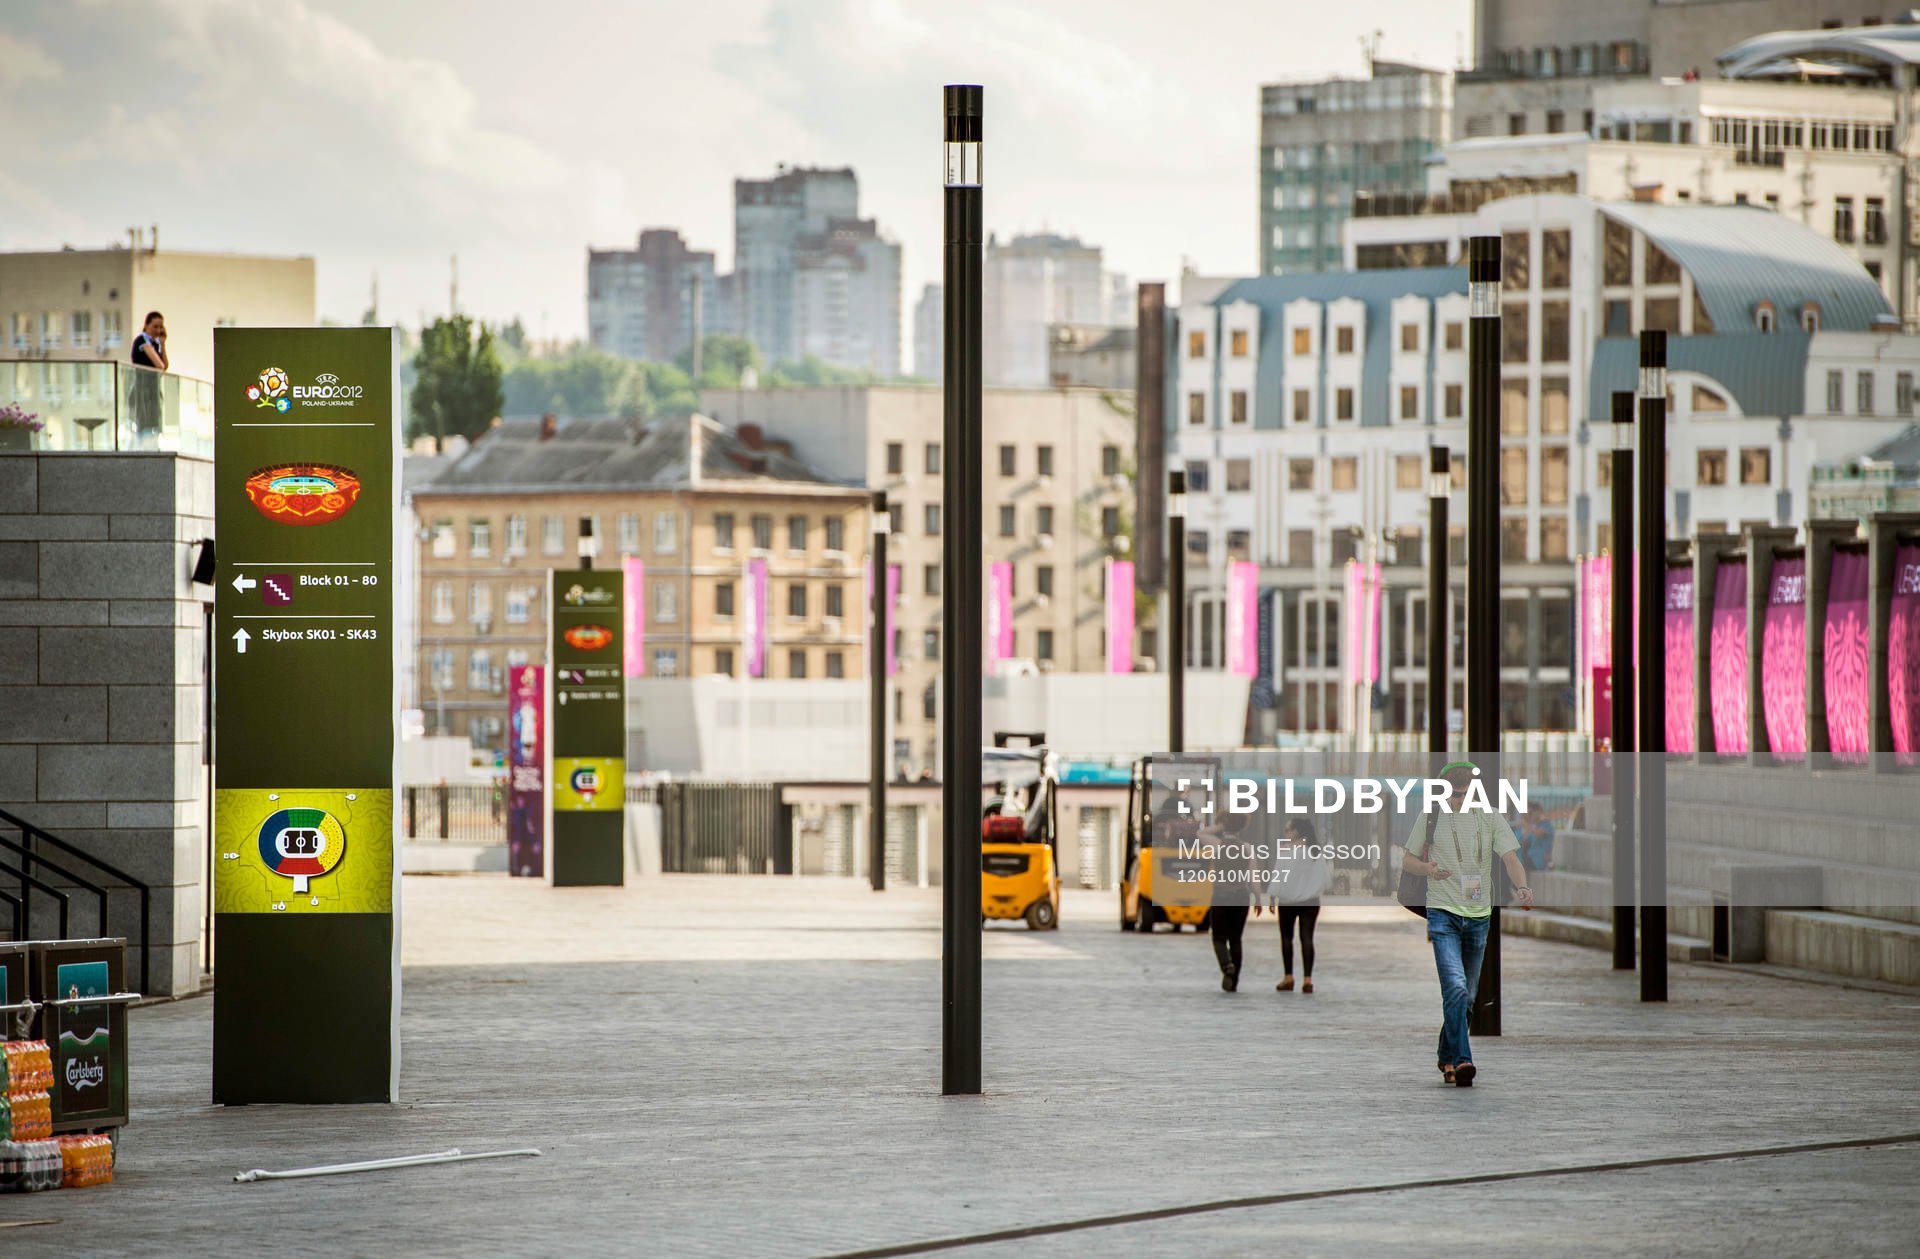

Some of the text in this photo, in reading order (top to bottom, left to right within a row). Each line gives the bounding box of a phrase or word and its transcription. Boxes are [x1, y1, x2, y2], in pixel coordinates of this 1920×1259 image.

[316, 374, 338, 384] UEFA
[299, 575, 332, 586] Block
[334, 575, 350, 586] 01
[361, 575, 378, 586] 80
[262, 629, 304, 642] Skybox
[306, 629, 337, 640] SK01
[346, 629, 377, 640] SK43
[65, 1056, 104, 1091] Carlsberg
